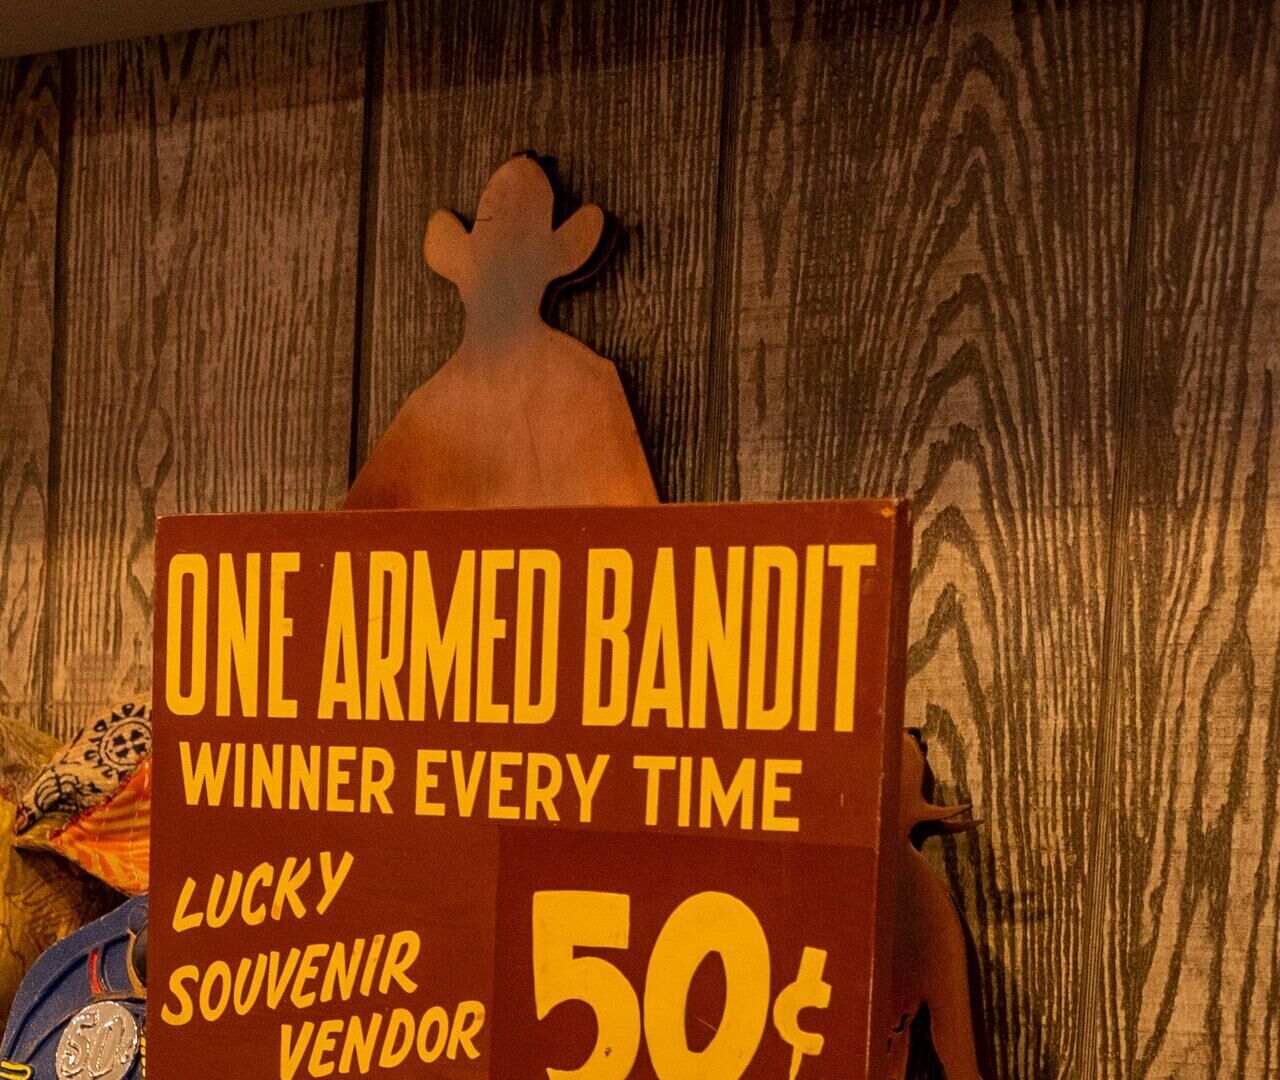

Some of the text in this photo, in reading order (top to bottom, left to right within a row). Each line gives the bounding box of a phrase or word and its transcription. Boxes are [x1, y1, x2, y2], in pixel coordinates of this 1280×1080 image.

[165, 543, 877, 733] ONE ARMED BANDIT
[179, 742, 803, 833] WINNER EVERY TIME
[172, 851, 355, 932] LUCKY
[160, 930, 421, 1026] SOUVENIR
